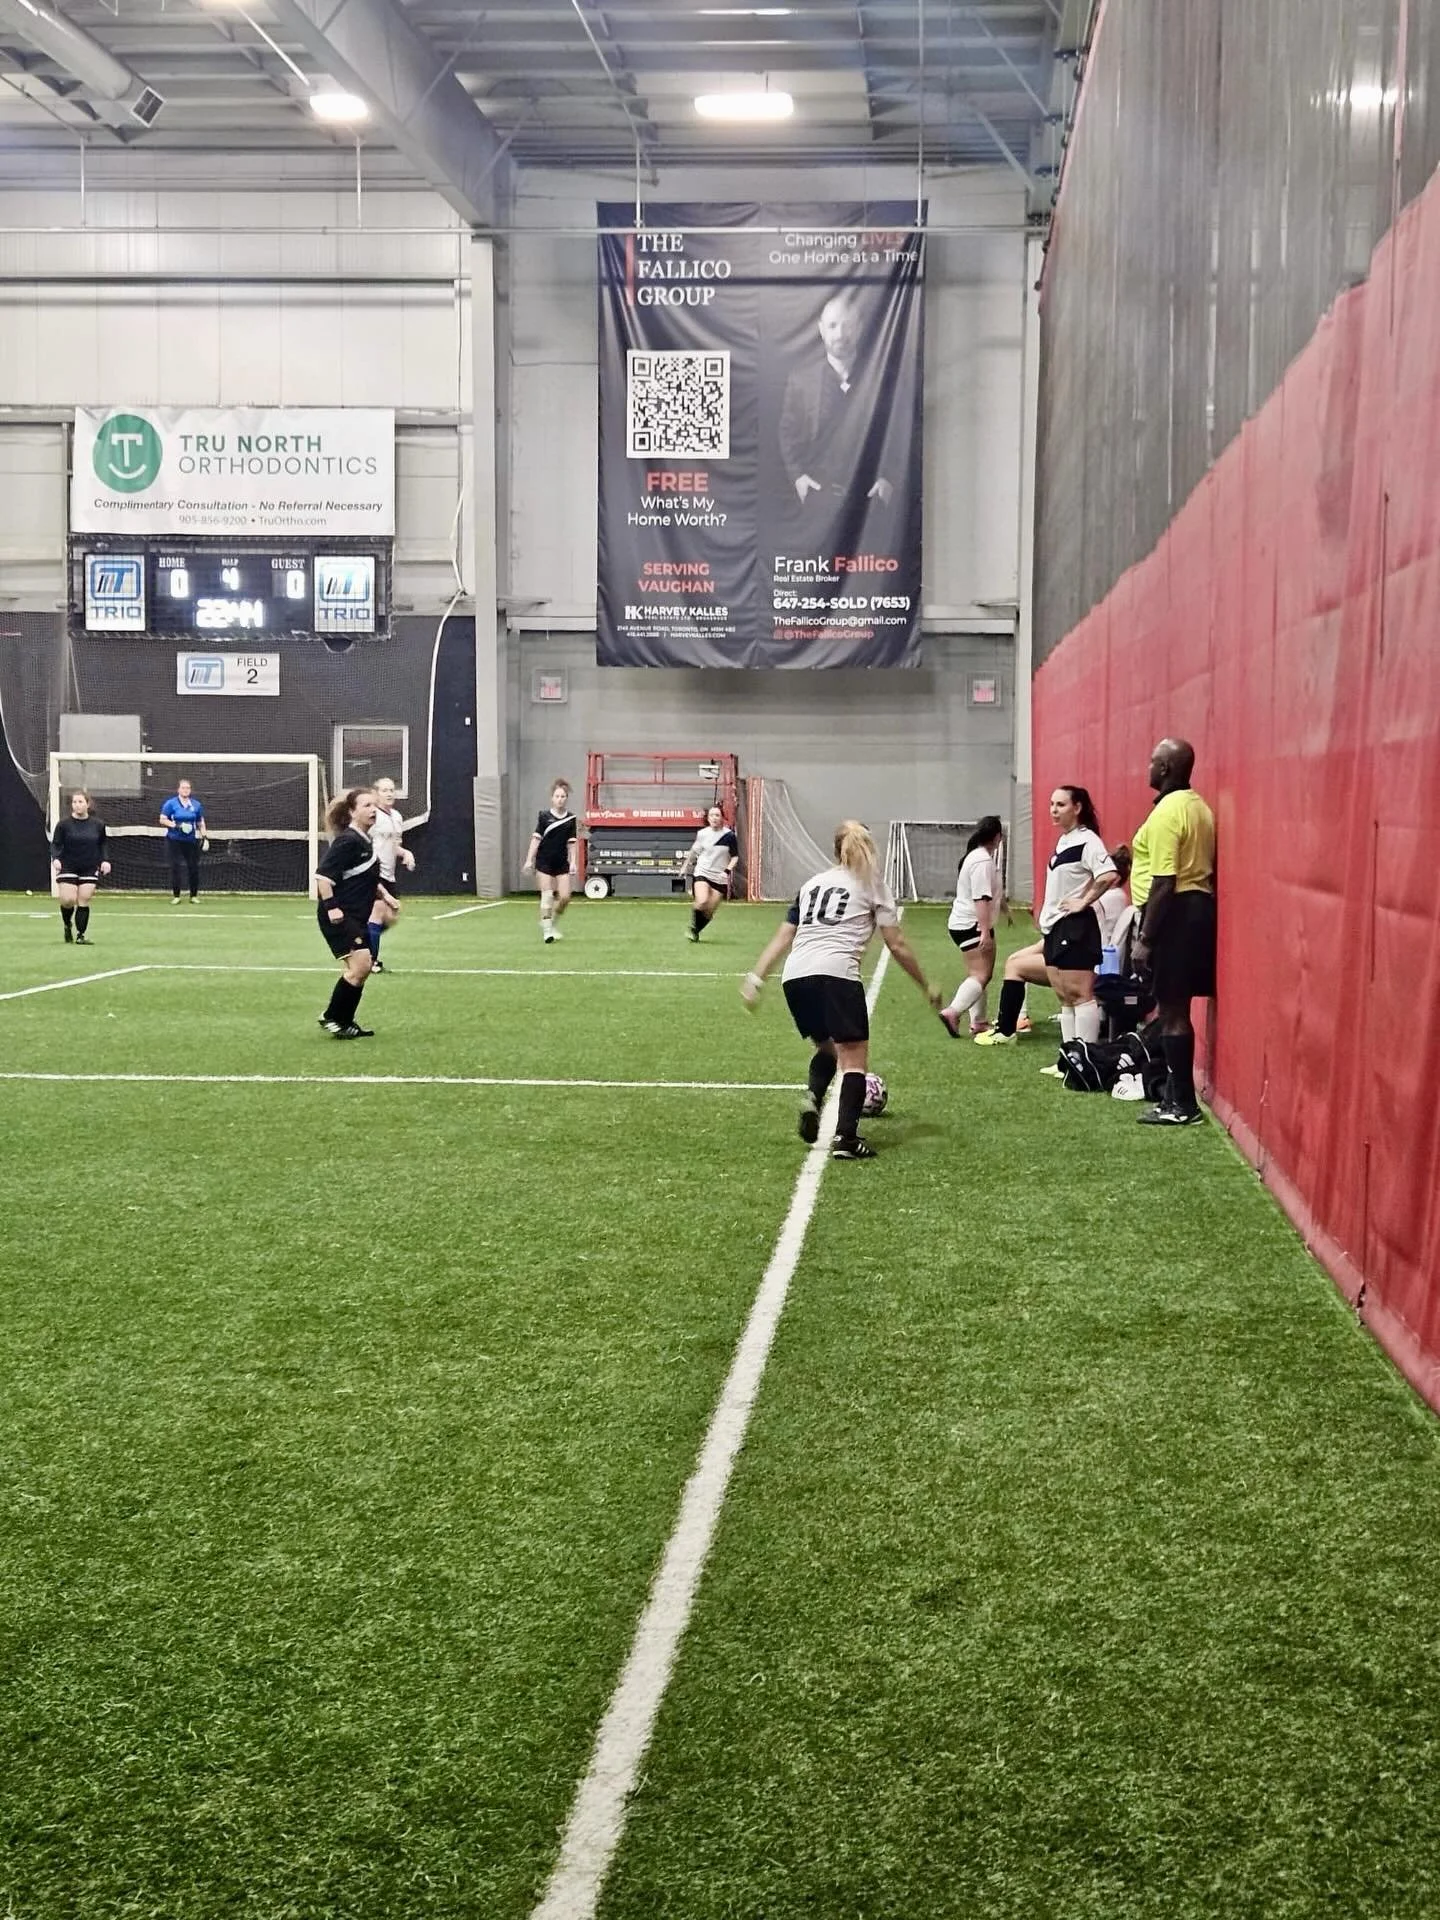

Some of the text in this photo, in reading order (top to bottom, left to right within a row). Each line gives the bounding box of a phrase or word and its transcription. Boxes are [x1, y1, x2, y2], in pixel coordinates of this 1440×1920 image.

[637, 234, 684, 251] THE
[785, 232, 905, 248] Changing LIVES
[769, 249, 918, 264] One Home at a Time
[637, 260, 731, 279] FALLICO
[637, 287, 715, 306] GROUP
[179, 435, 322, 453] TRU NORTH
[178, 456, 377, 475] ORTHODONTICS
[647, 472, 709, 492] FREE
[94, 499, 174, 511] Complimentary
[177, 499, 248, 511] Consultation
[259, 501, 275, 511] No
[278, 501, 322, 511] Referral
[325, 501, 383, 512] Necessary
[640, 496, 715, 512] What's My
[628, 512, 727, 526] Home Worth?
[159, 557, 185, 568] HOME
[272, 558, 305, 569] GUEST
[643, 562, 710, 575] SERVING
[775, 555, 898, 573] Frank Fallico
[638, 580, 715, 593] VAUGHAN
[644, 606, 687, 616] HARVEY
[689, 606, 729, 616] KALLES
[773, 596, 910, 611] 647-254-SOLD (7653)
[90, 606, 141, 619] TRIO
[319, 607, 370, 620] TRIO
[773, 616, 907, 627] TheFallicoGroup@gmail.com
[237, 658, 268, 667] FIELD
[246, 668, 259, 684] 2
[802, 885, 850, 926] 10
